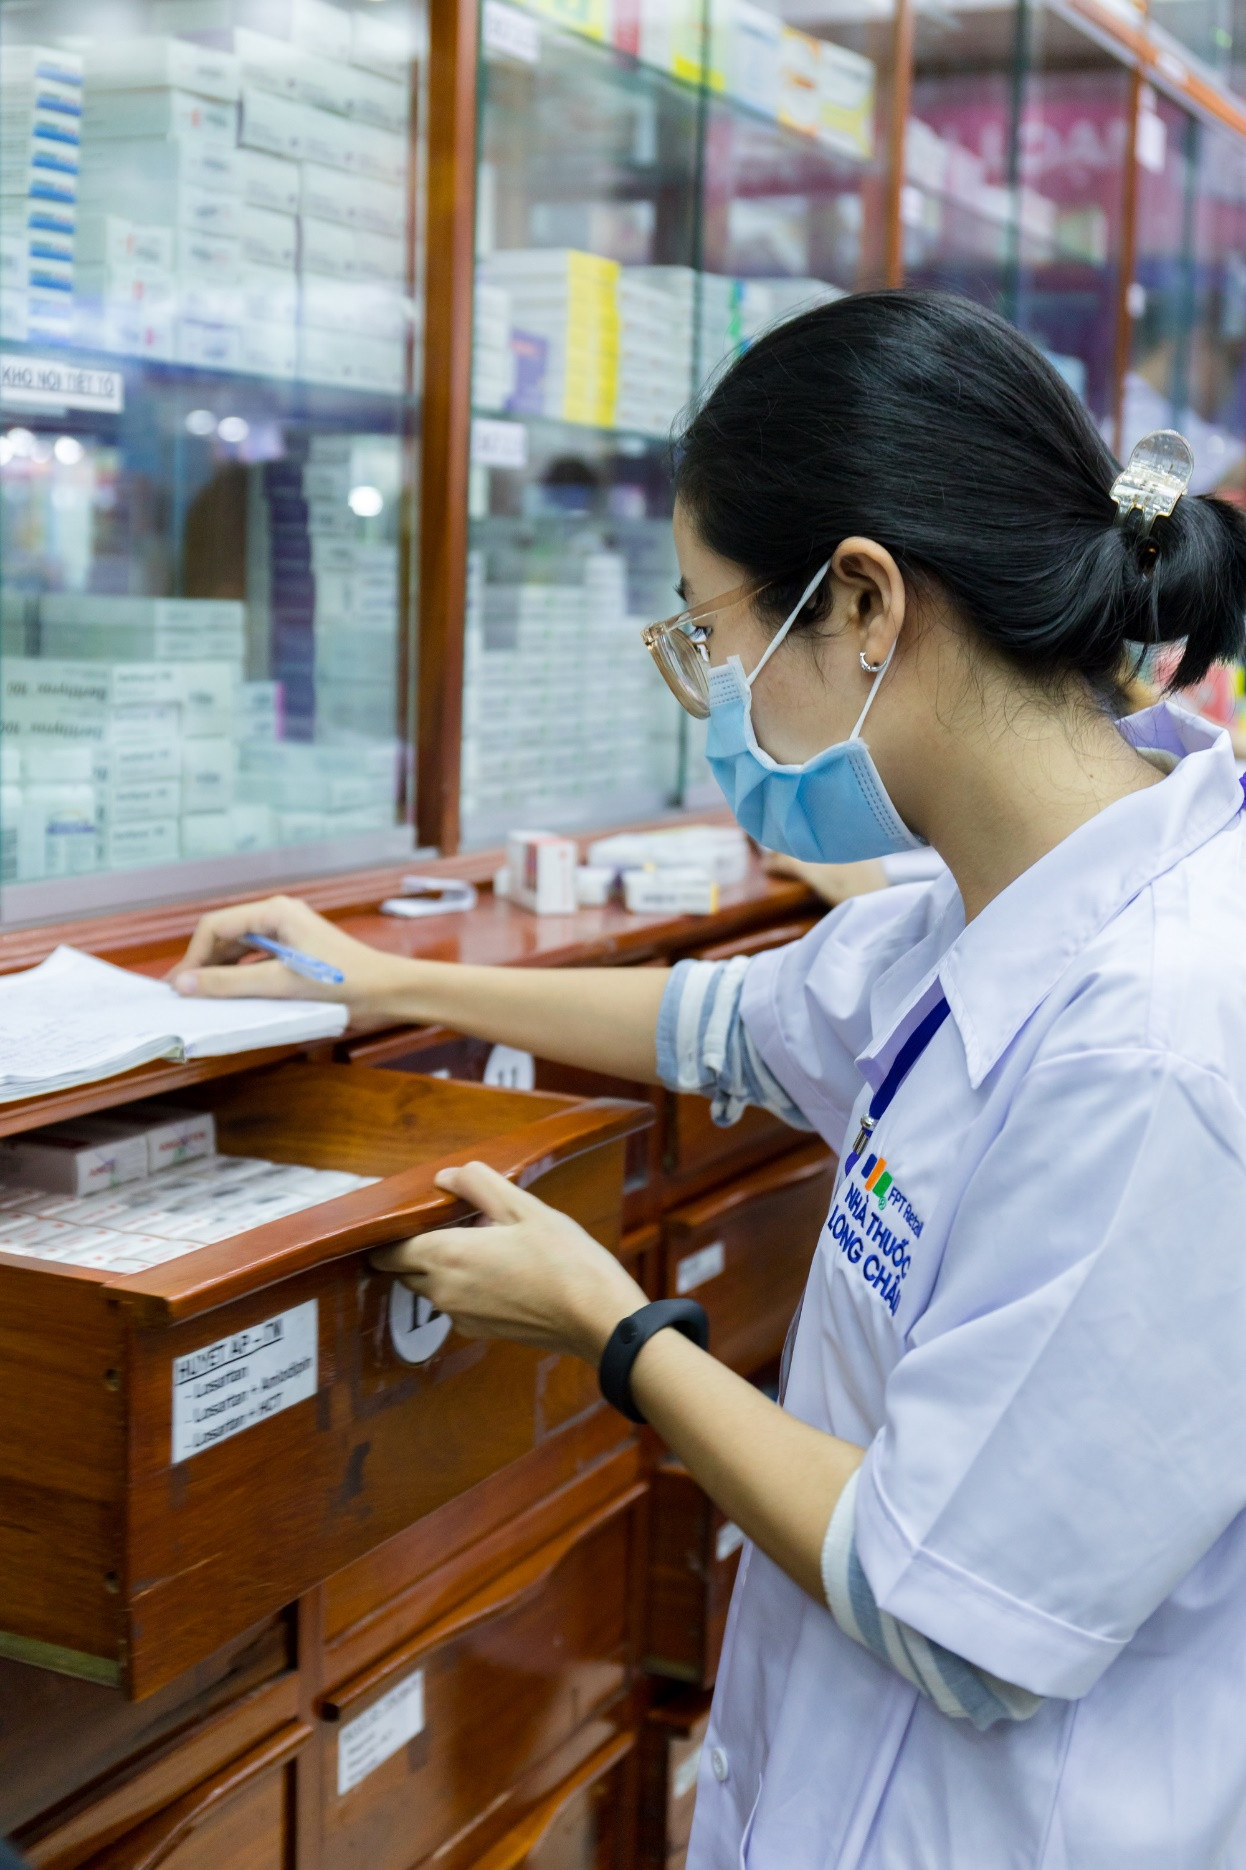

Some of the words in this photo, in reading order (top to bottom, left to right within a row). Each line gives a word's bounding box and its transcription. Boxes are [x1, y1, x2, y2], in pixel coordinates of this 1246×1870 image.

[827, 1204, 864, 1264] LONG
[844, 1182, 870, 1229] NHÀ
[866, 1212, 912, 1279] THUỐC
[888, 1186, 908, 1213] FPT
[903, 1205, 925, 1240] Retail
